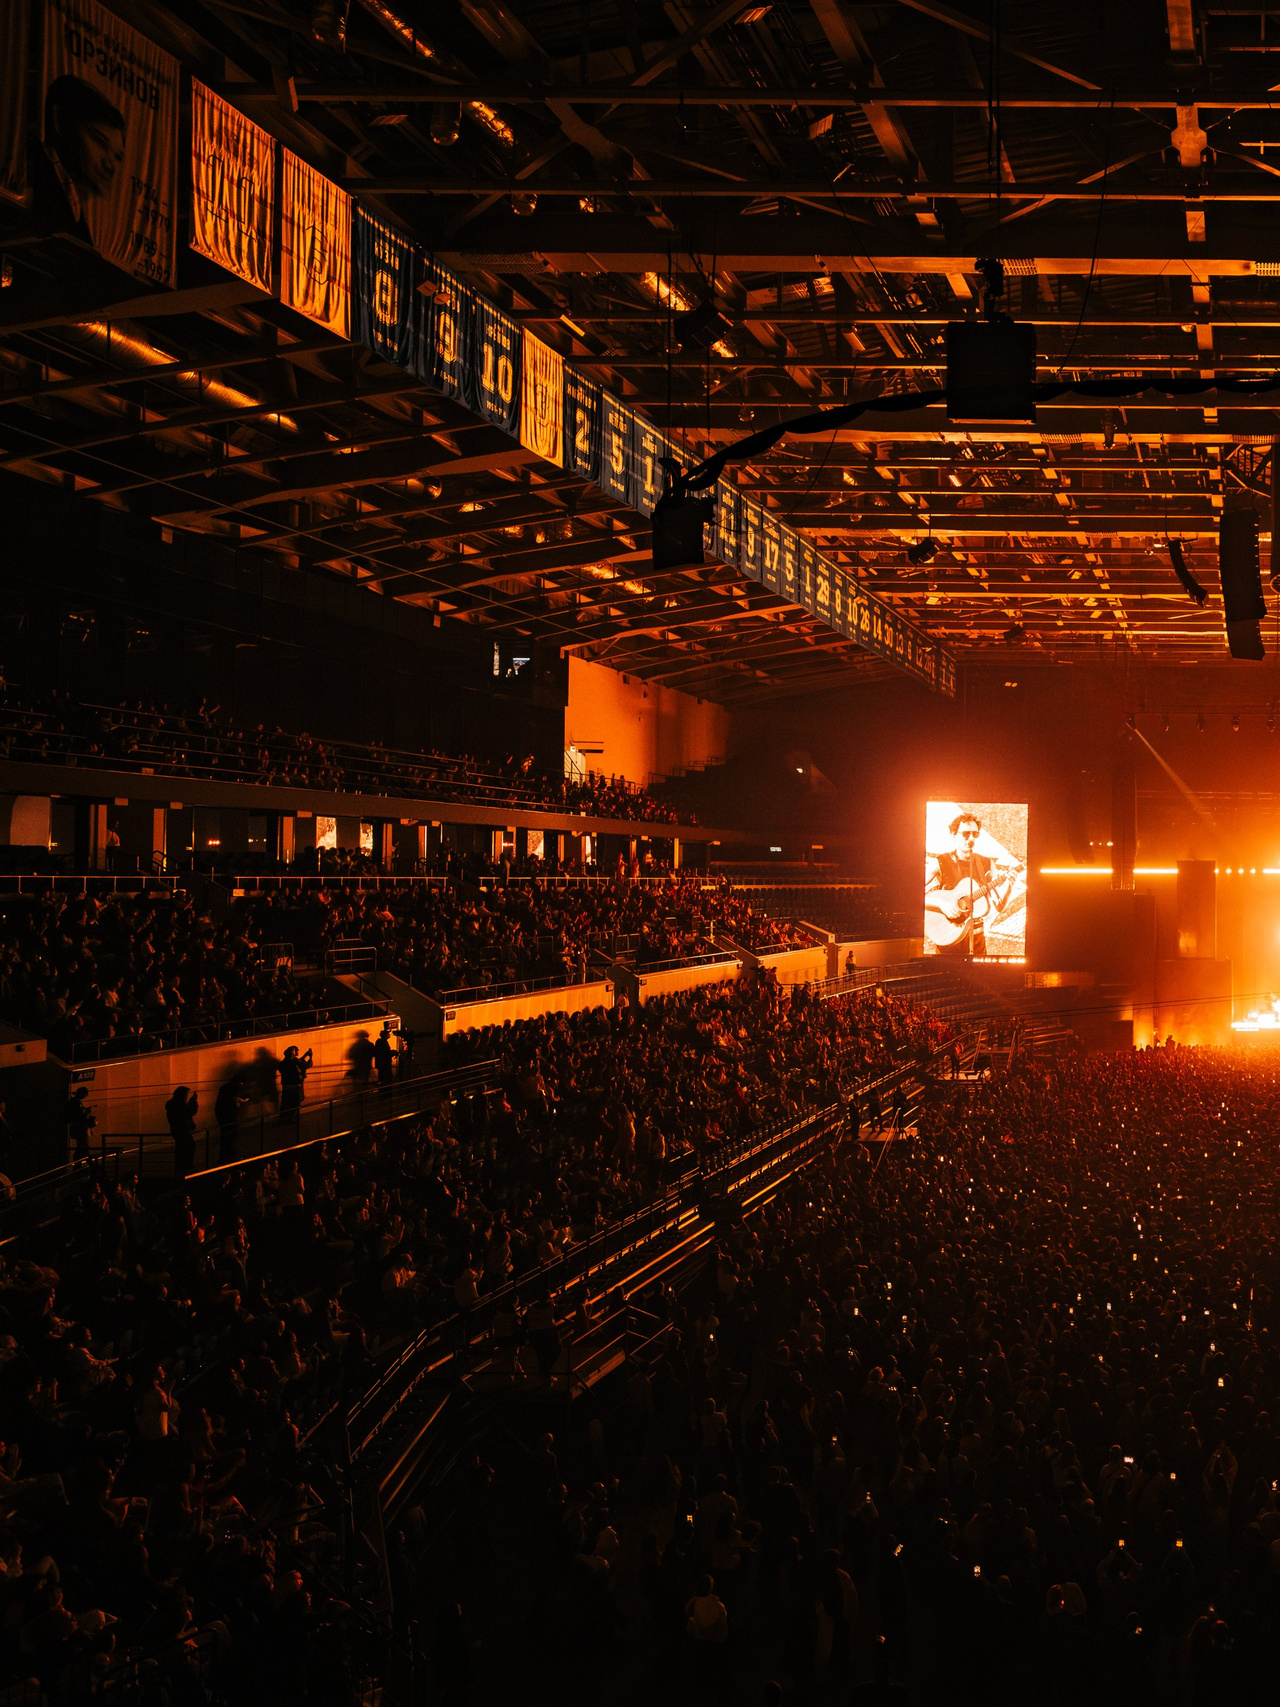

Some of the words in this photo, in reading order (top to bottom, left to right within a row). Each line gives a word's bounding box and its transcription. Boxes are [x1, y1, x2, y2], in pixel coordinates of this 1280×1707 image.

[373, 270, 398, 327] 8
[437, 311, 458, 363] 9
[481, 342, 513, 404] 10
[575, 408, 590, 455] 2
[610, 431, 625, 475] 5
[644, 455, 655, 496] 1
[765, 537, 780, 572] 17
[785, 550, 794, 582] 5
[805, 565, 811, 594] 1
[816, 575, 830, 607] 29
[835, 588, 841, 615] 8
[847, 597, 858, 626] 10
[873, 614, 883, 642] 14
[884, 622, 893, 648] 30
[895, 631, 904, 655] 13
